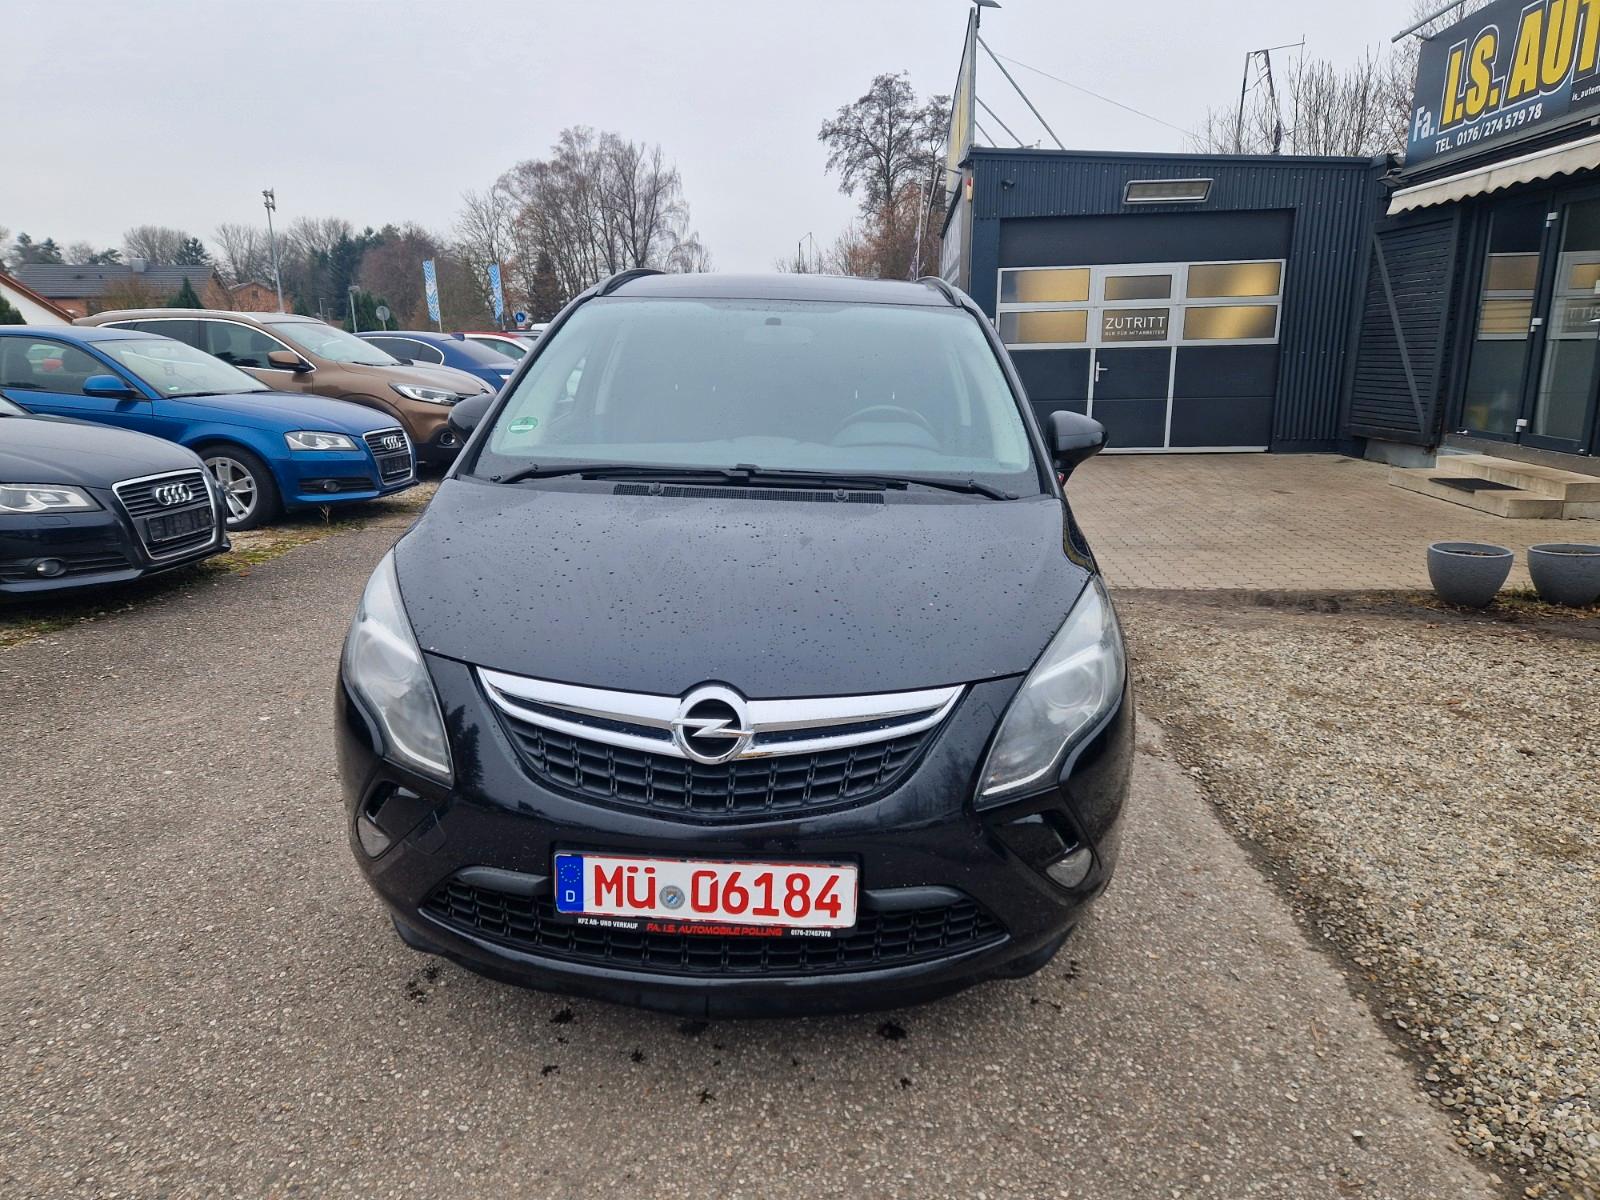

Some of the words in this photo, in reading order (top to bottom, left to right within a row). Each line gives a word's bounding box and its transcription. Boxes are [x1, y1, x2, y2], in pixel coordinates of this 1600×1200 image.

[1412, 105, 1434, 142] Fa.
[1442, 34, 1500, 125] I.S.
[1435, 139, 1453, 154] TEL.
[1527, 102, 1543, 122] 78
[1105, 316, 1166, 329] ZUTRITT
[565, 889, 575, 903] D
[594, 864, 656, 910] MÜ
[691, 870, 842, 918] 06184
[612, 920, 639, 929] VERKAUF
[677, 925, 741, 936] AUTOMOBILE
[742, 927, 784, 937] POLLING
